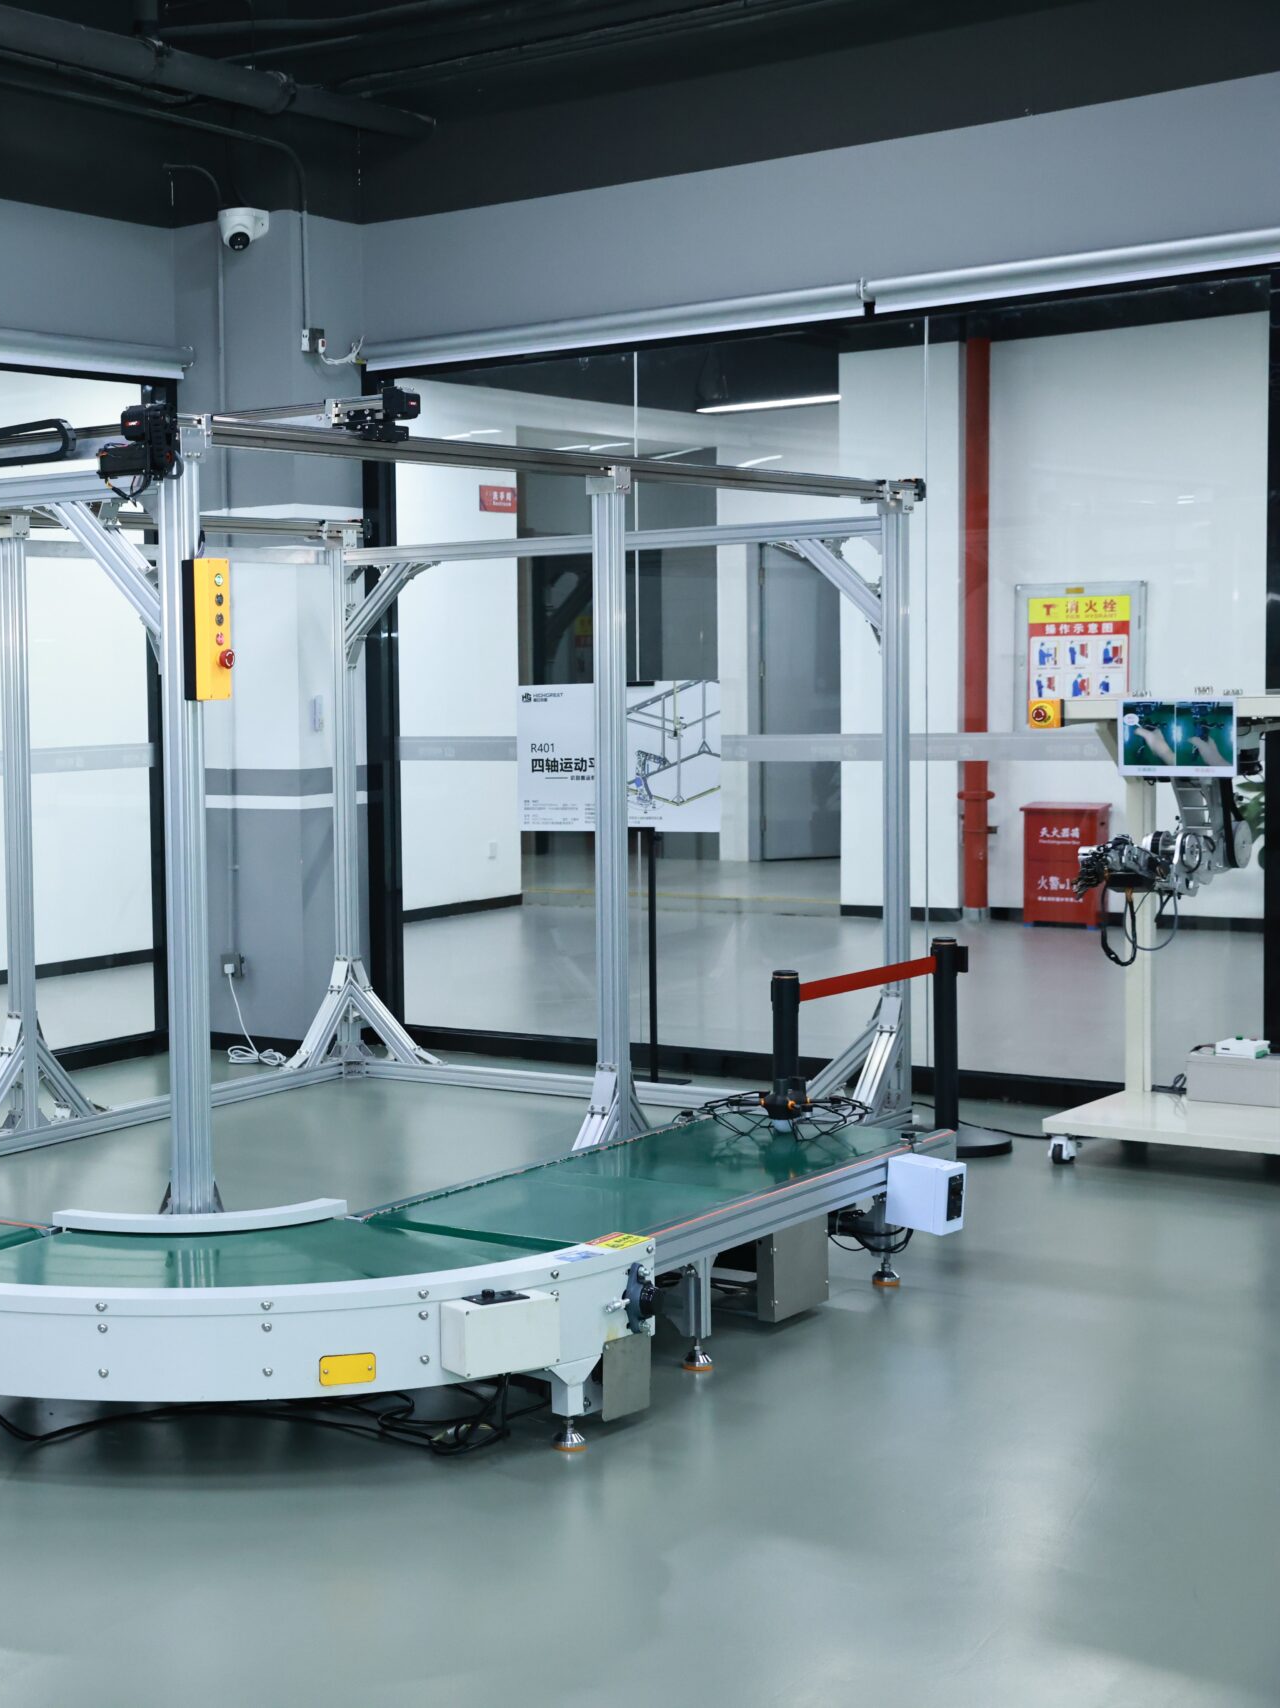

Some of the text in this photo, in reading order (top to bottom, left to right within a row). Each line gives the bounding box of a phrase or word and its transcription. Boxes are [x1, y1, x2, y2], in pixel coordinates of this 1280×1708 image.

[1065, 599, 1117, 614] 消火栓
[1045, 622, 1114, 635] 操作示意图
[530, 743, 555, 753] R401
